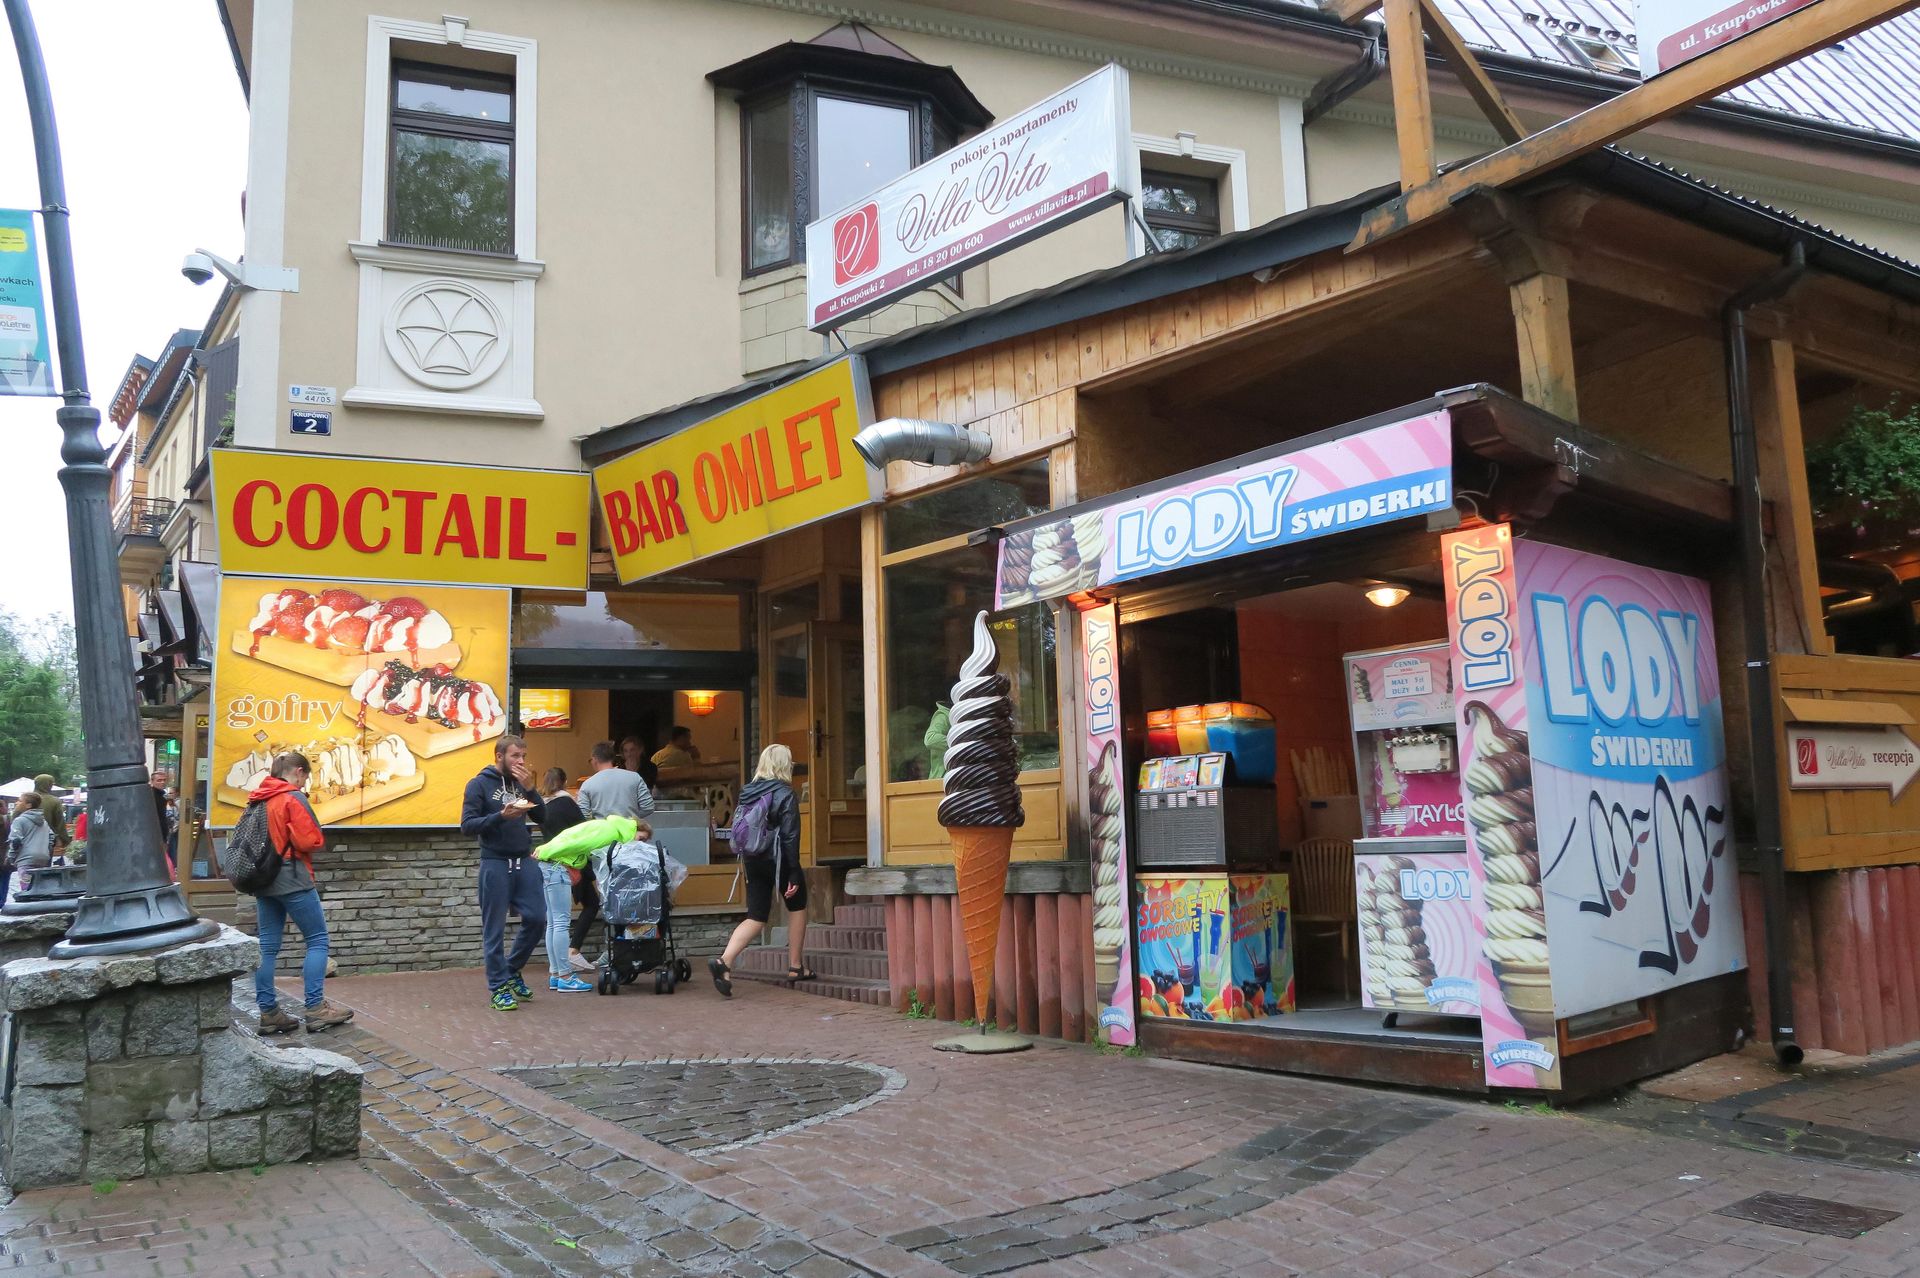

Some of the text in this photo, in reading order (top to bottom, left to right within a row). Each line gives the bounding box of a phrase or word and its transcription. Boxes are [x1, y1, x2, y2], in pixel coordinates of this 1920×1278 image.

[1679, 34, 1700, 51] ul.
[950, 98, 1078, 174] pokoje i apartamenty
[896, 137, 1051, 253] Villa Vita
[1008, 184, 1087, 230] www.villavita.pl
[906, 233, 984, 277] tel. 18 20 00 600
[829, 279, 885, 312] ul. Krupówki 2
[293, 411, 329, 419] KRUPÓWKI
[304, 418, 317, 432] 2
[603, 396, 842, 557] BAR OMLET
[1116, 467, 1446, 572] LODY ŚWIDERKI
[1454, 543, 1513, 690] LODY
[1088, 619, 1115, 734] LODY
[1393, 660, 1419, 668] CENNIK
[1531, 592, 1700, 728] LODY
[227, 692, 343, 729] gofry
[1591, 729, 1694, 766] ŚWIDERKI
[1872, 749, 1914, 766] recepcja
[1401, 869, 1471, 900] LODY
[1138, 889, 1221, 927] SORBETY
[1139, 917, 1200, 944] OWOCOWE
